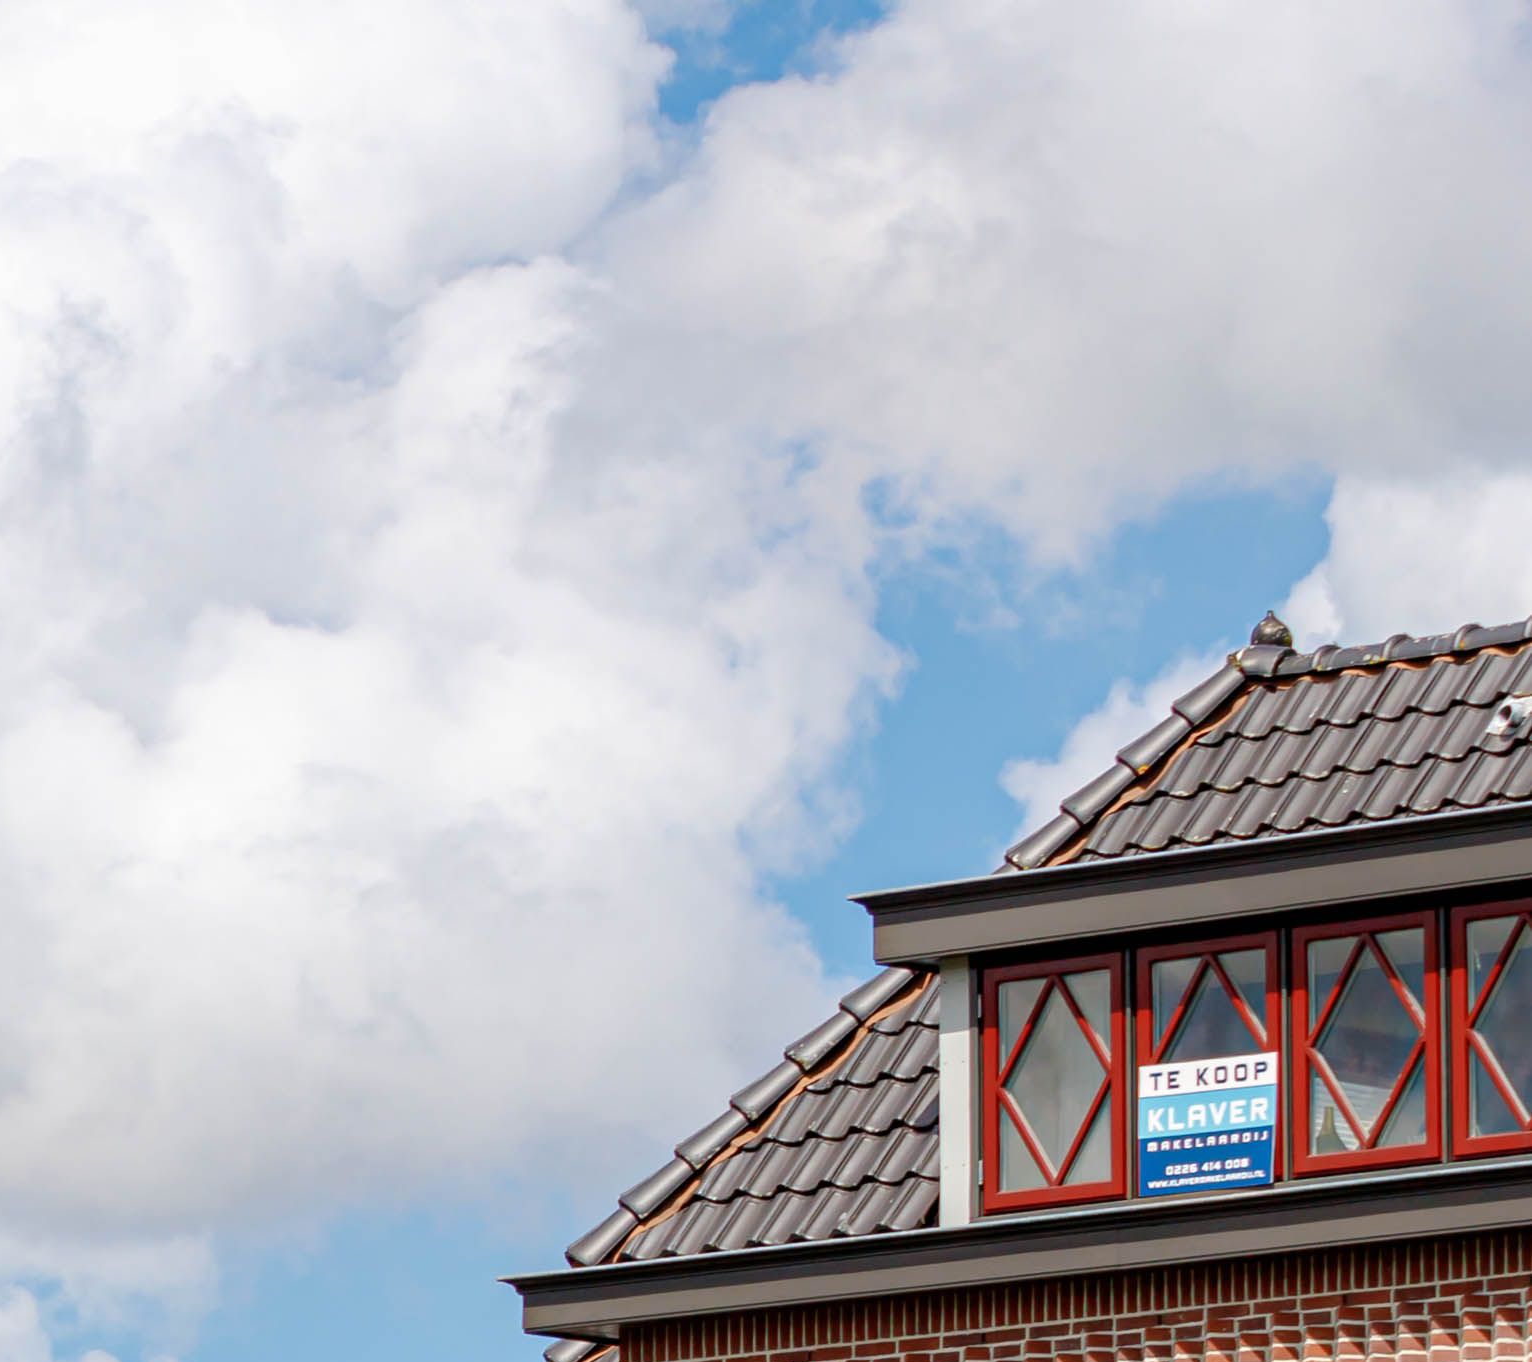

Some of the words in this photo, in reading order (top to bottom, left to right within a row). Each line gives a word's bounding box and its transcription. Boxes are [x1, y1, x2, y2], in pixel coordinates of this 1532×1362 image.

[1149, 1071, 1180, 1091] TE
[1196, 1061, 1268, 1087] KOOP
[1147, 1097, 1269, 1132] KLAVER
[1146, 1131, 1269, 1152] MAKELAARDIJ
